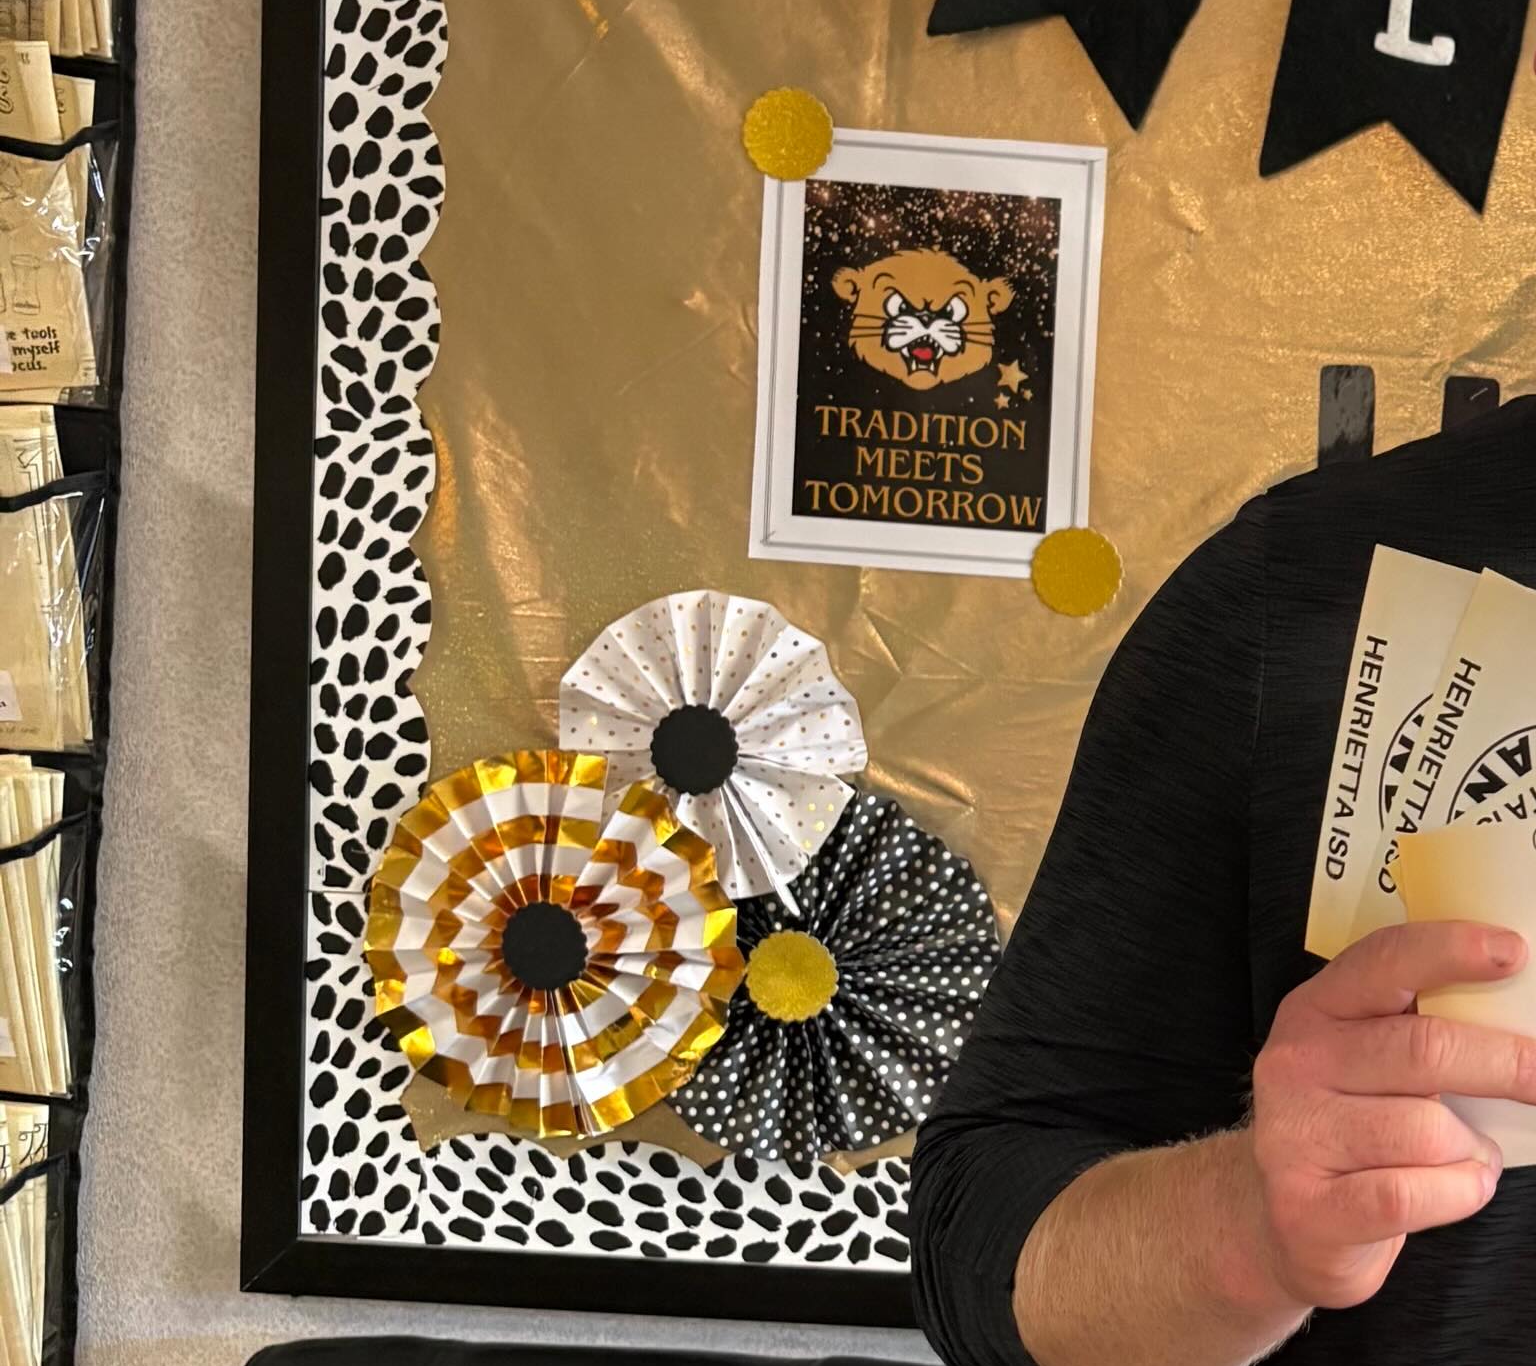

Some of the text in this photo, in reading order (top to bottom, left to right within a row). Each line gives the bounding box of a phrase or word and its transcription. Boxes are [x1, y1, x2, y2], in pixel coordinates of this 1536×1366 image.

[12, 340, 60, 361] myself
[22, 326, 57, 340] tools
[814, 405, 1027, 451] TRADITION
[856, 446, 985, 485] MEETS
[805, 480, 1043, 528] TOMORROW
[1325, 635, 1388, 881] HENRIETTA ISD
[1395, 657, 1482, 834] HENRIETTA
